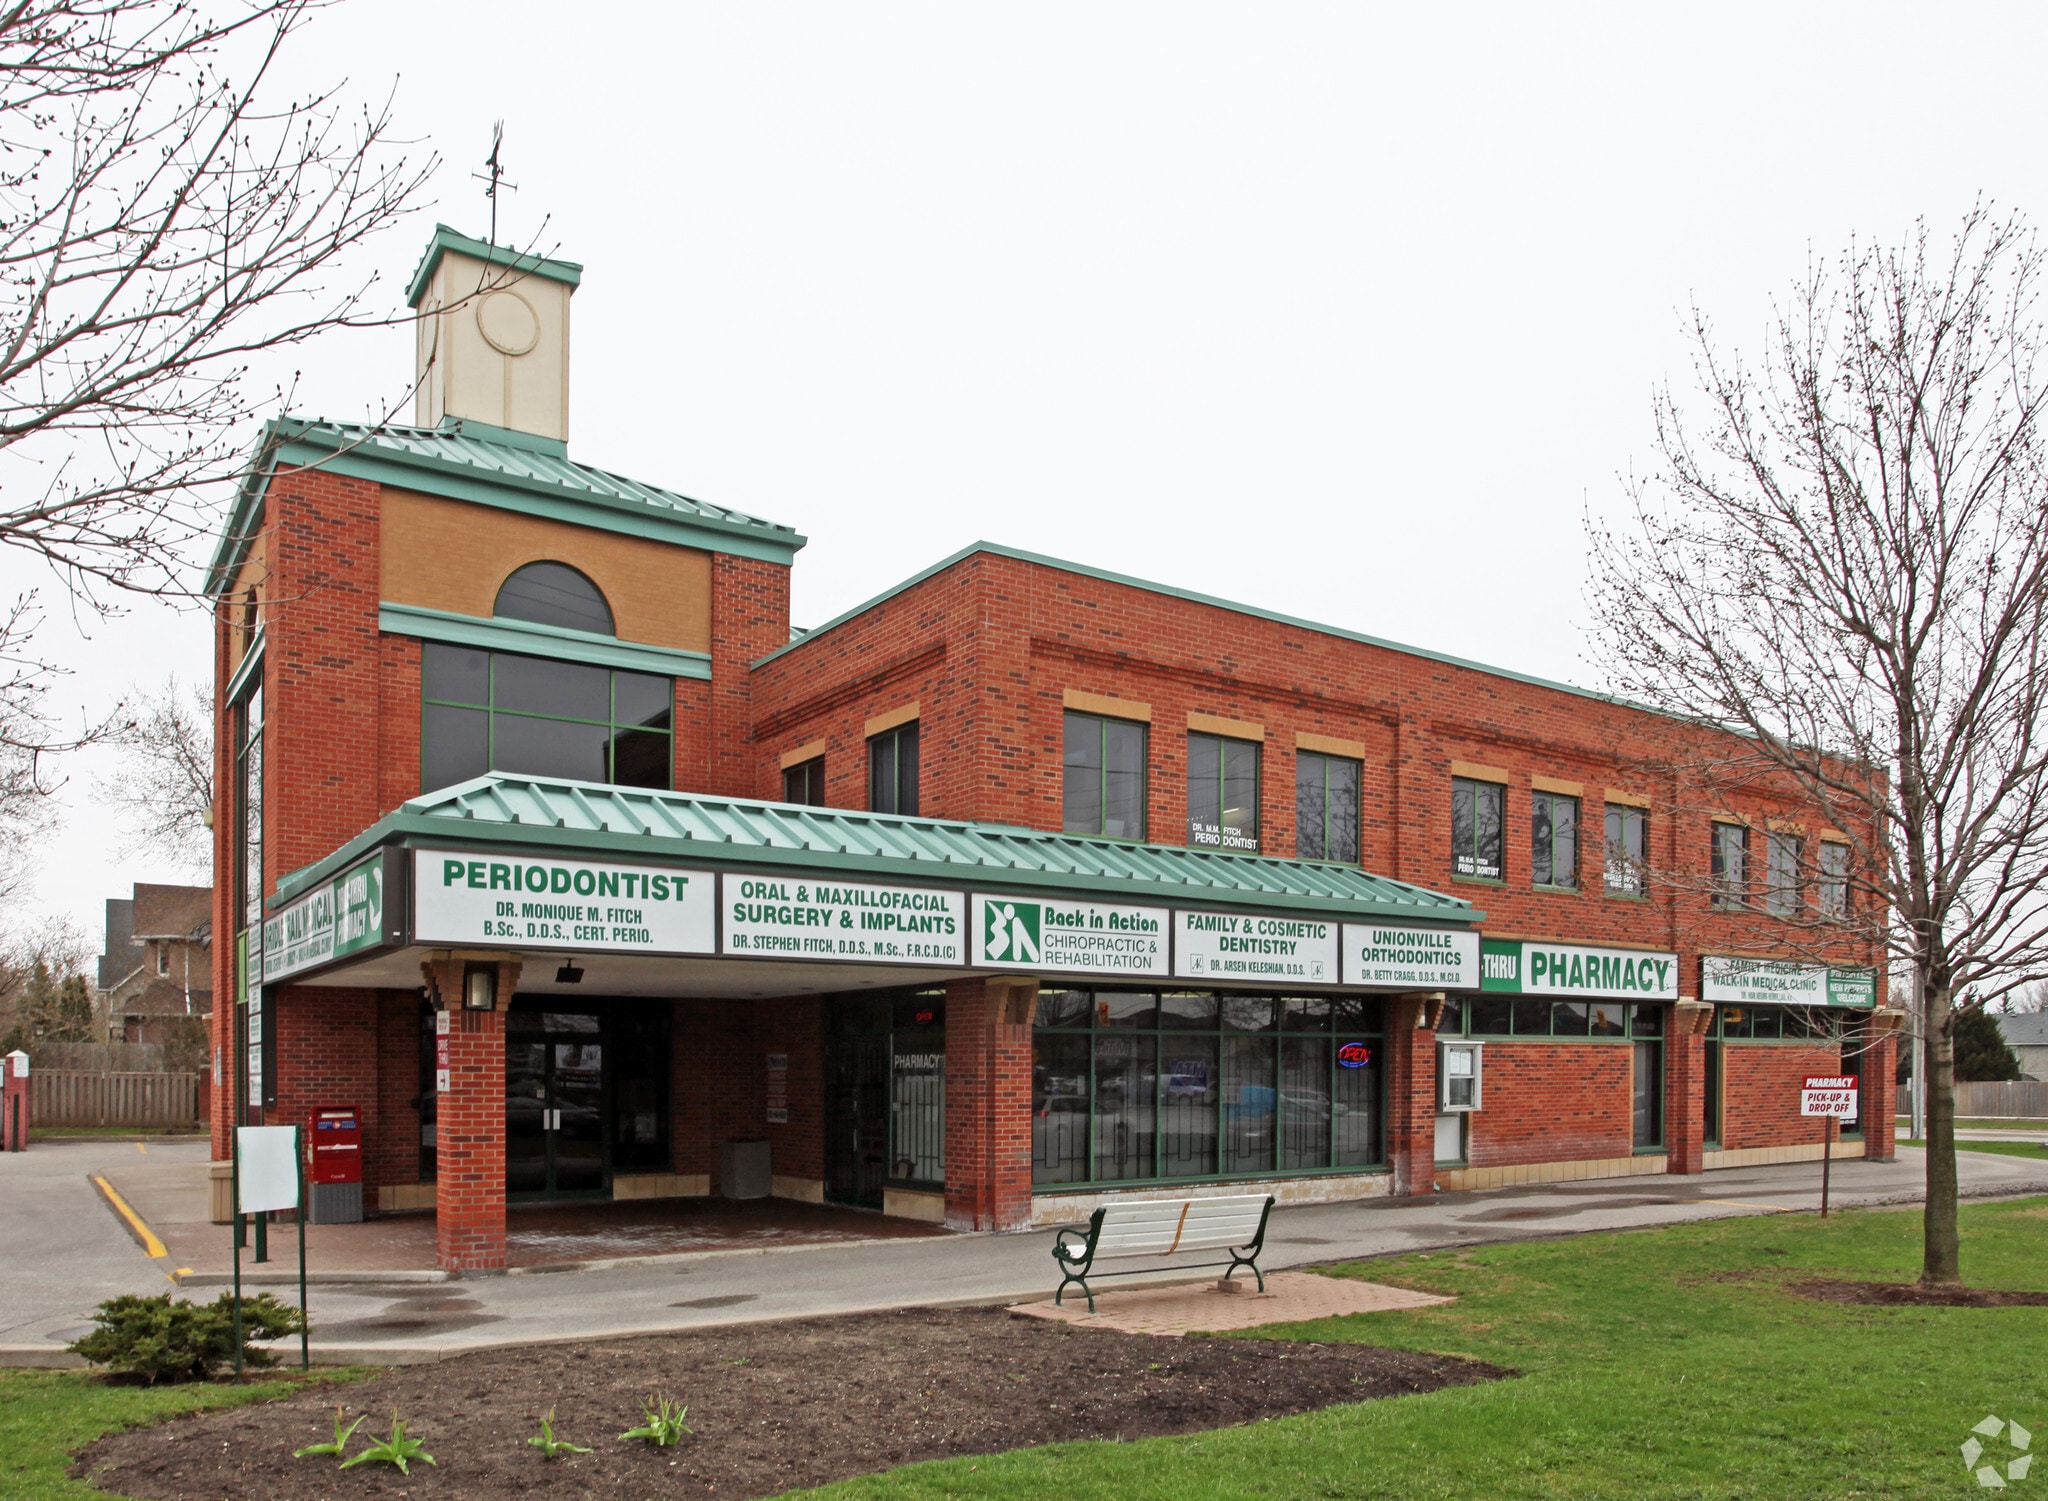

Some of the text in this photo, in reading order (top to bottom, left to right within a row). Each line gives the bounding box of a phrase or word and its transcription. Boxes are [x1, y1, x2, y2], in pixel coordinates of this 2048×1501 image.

[1193, 823, 1241, 836] DR. M.M. FITCH
[1195, 832, 1258, 850] PERIO DONTIST
[443, 860, 689, 902] PERIODONTIST
[741, 880, 950, 912] ORAL & MAXILLOFACIAL
[496, 901, 642, 924] DR. MONIQUE M. FITCH
[733, 903, 956, 934] SURGERY & IMPLANTS
[1045, 906, 1158, 932] Back in Action
[527, 922, 570, 941] D.D.S.,
[574, 925, 608, 941] CERT.
[612, 928, 654, 944] PERIO.
[1187, 914, 1327, 940] FAMILY & COSMETIC
[733, 934, 750, 948] DR.
[753, 935, 800, 951] STEPHEN
[804, 938, 836, 955] FITCH,
[839, 940, 872, 956] D.D.S.,
[907, 944, 956, 960] F.R.C.D.(C)
[1044, 934, 1158, 953] CHIROPRACTIC &
[1220, 936, 1297, 956] DENTISTRY
[1373, 930, 1452, 948] UNIONVILLE
[1046, 952, 1152, 968] REHABILITATION
[1362, 948, 1462, 966] ORTHODONTICS
[1730, 960, 1760, 972] FAMILY
[1210, 960, 1222, 971] DR.
[1224, 961, 1246, 972] ARSEN
[1248, 962, 1286, 976] KELESHIAN,
[1287, 964, 1306, 975] D.D.S.
[1362, 969, 1374, 980] DR.
[1374, 970, 1392, 980] BETTY
[1394, 970, 1417, 982] CRAGG,
[1419, 972, 1438, 983] D.D.S.,
[1531, 952, 1670, 992] PHARMACY
[1713, 972, 1817, 990] WALK-IN MEDICAL CLINIC
[1830, 982, 1843, 992] NEW
[1836, 993, 1867, 1003] WELCOME
[894, 1054, 940, 1068] PHARMACY
[1338, 1047, 1370, 1062] OPEN
[1174, 1060, 1206, 1078] ATM
[1806, 1078, 1854, 1088] PHARMACY
[1808, 1093, 1850, 1102] PICK-UP &
[1809, 1104, 1850, 1112] DROP OFF
